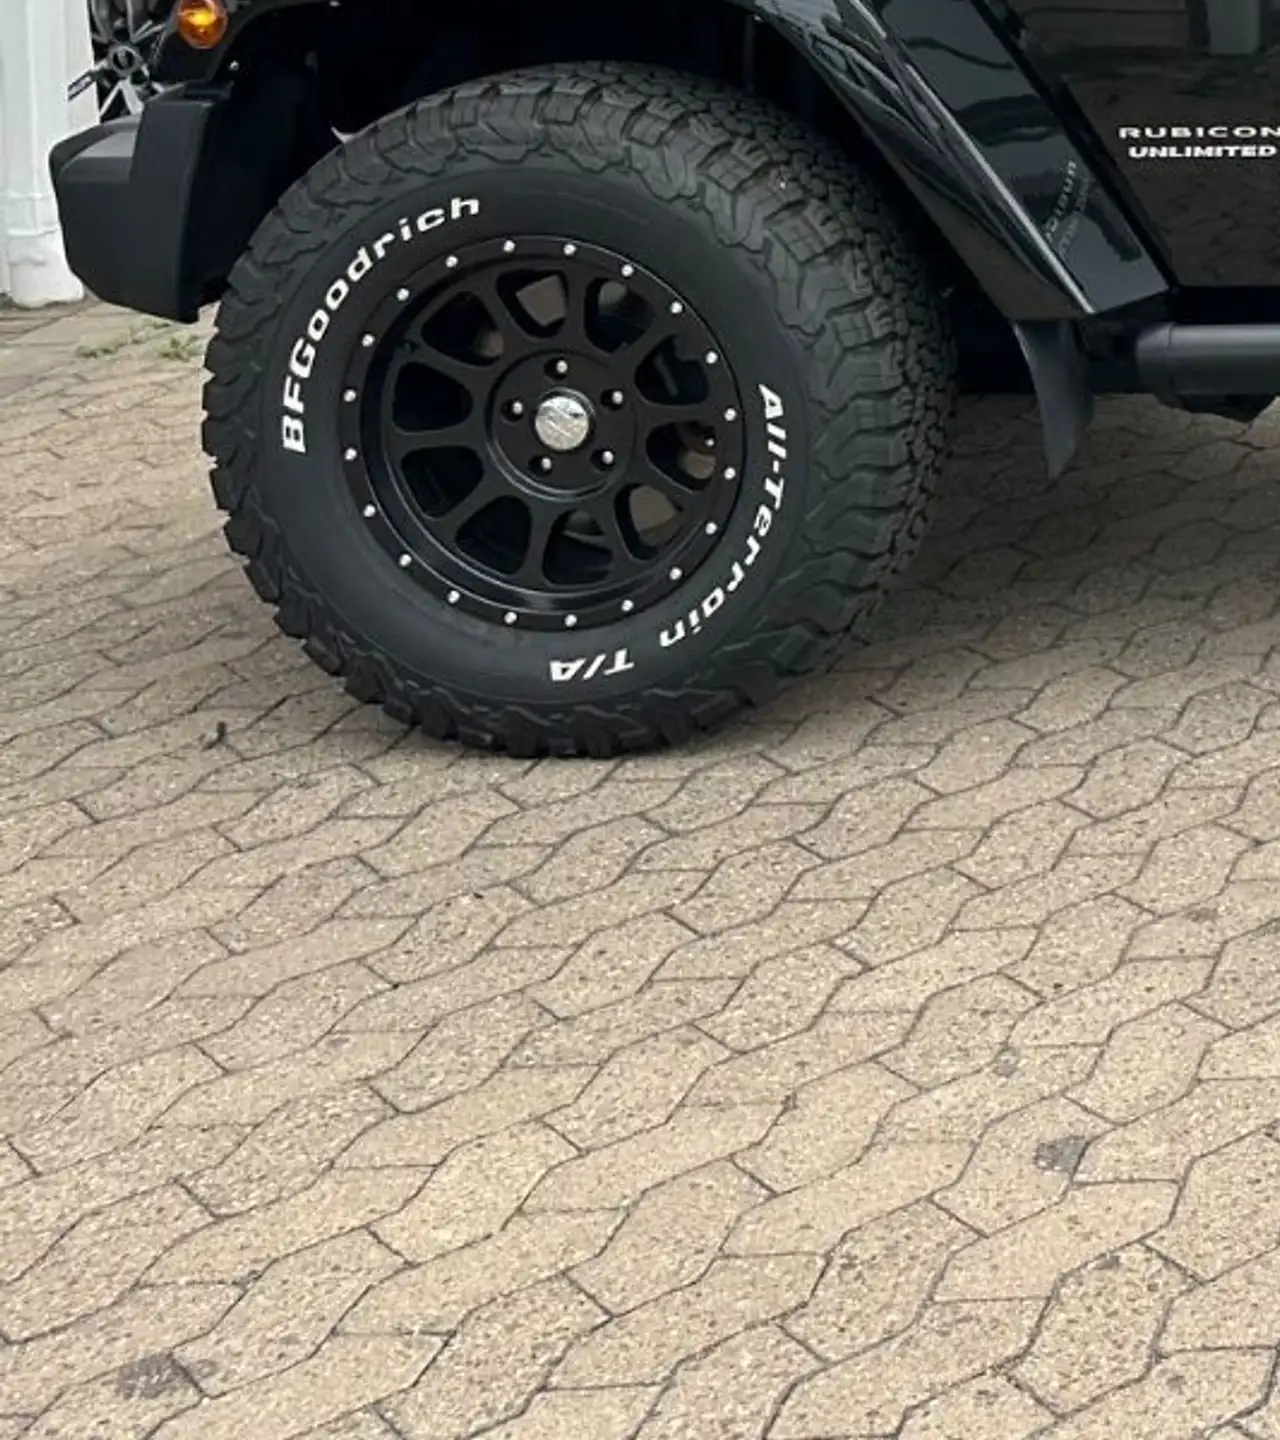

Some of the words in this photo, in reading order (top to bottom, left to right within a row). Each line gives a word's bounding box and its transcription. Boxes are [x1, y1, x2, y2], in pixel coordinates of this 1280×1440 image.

[1128, 145, 1278, 159] UNLIMITED
[281, 197, 480, 453] BFGoodrich
[659, 384, 787, 648] All-Terrain
[549, 648, 635, 682] T/A
